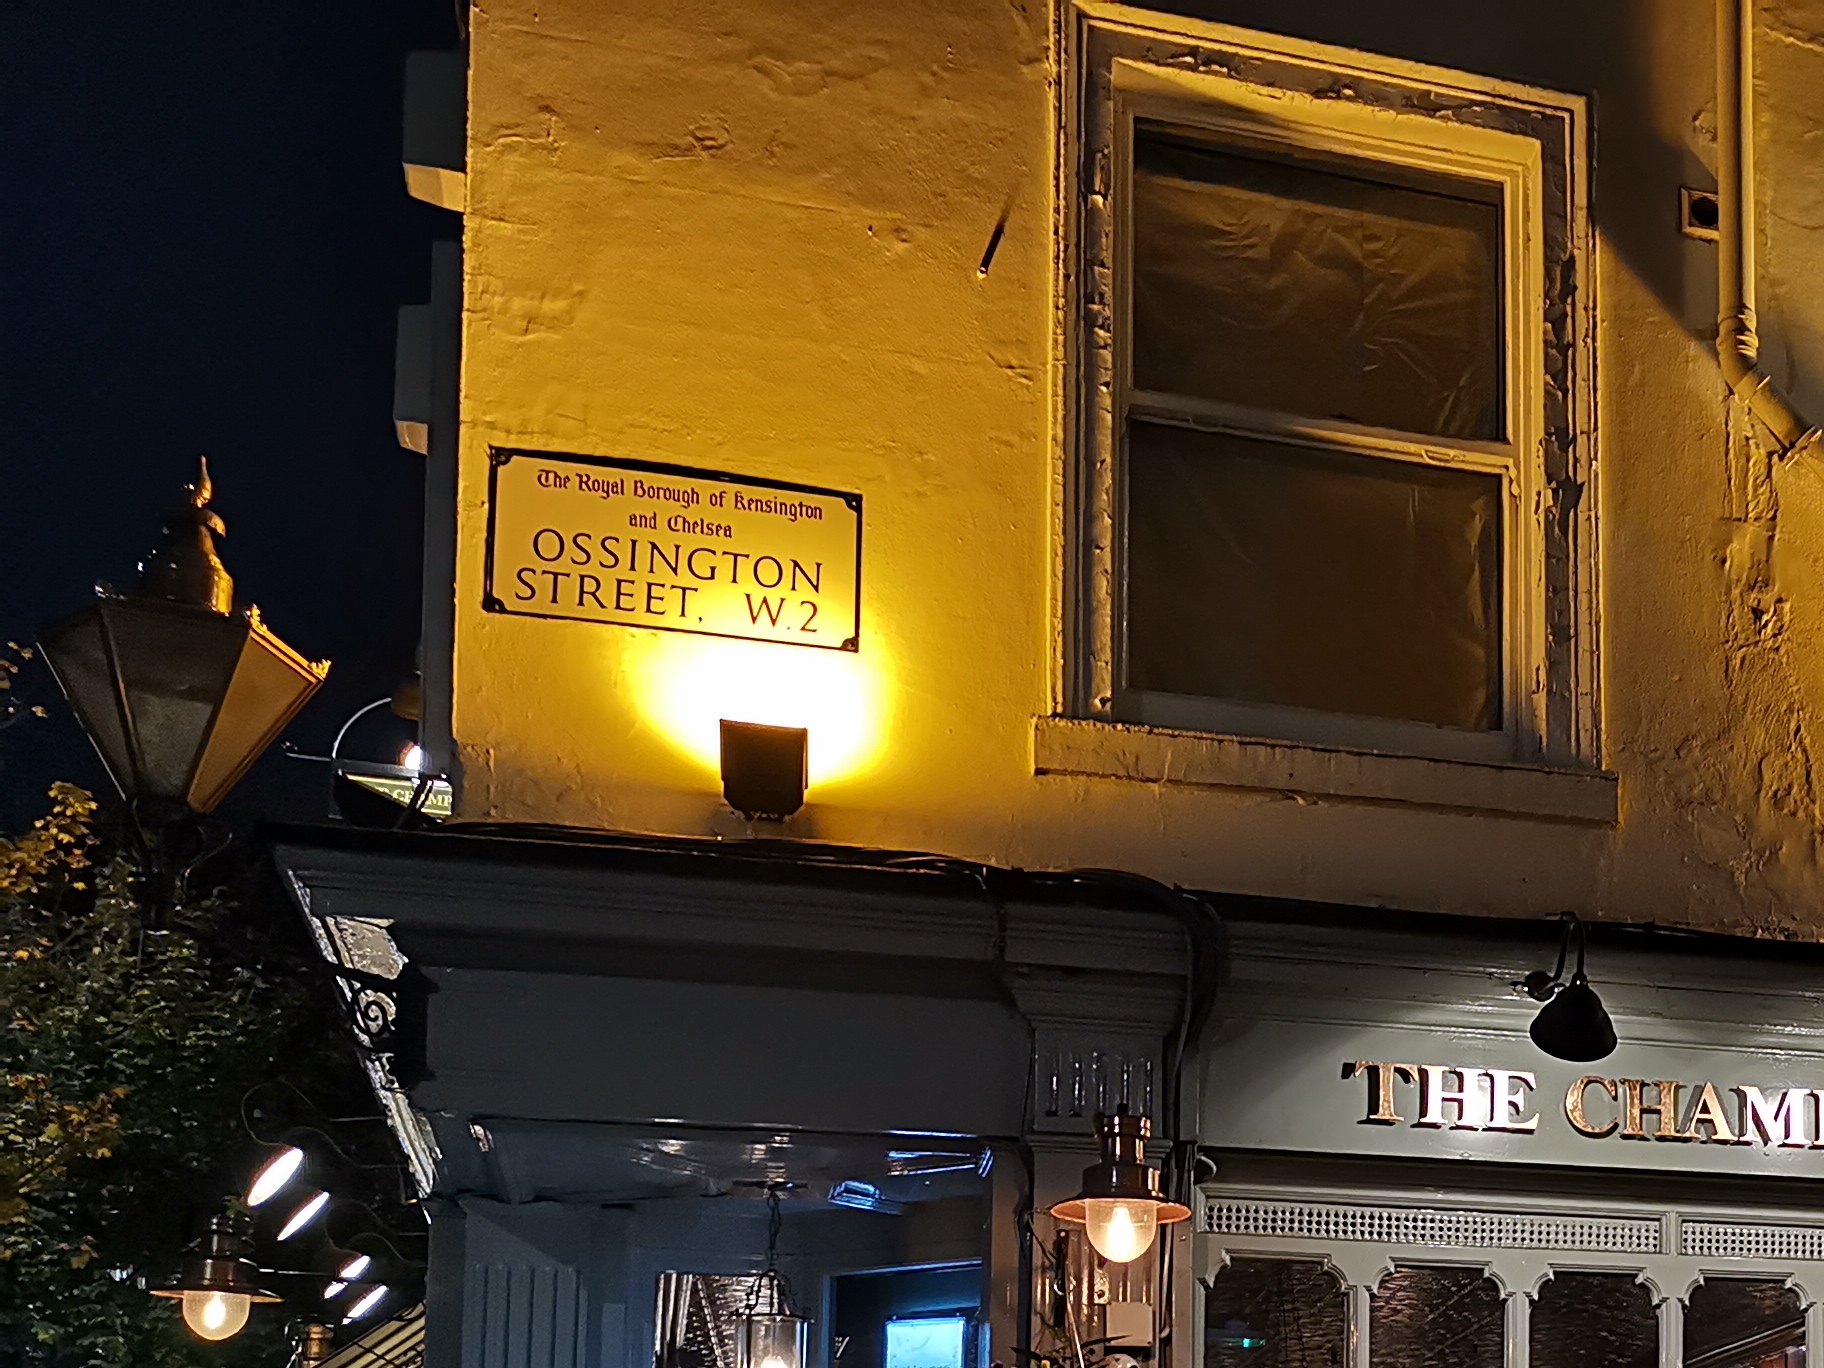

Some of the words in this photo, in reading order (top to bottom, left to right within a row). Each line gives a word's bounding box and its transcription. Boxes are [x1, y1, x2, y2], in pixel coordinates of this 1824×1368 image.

[537, 469, 571, 489] The
[575, 472, 625, 500] Royal
[633, 479, 700, 509] Borough
[709, 490, 727, 508] of
[734, 491, 823, 523] Kensington
[629, 511, 657, 530] and
[667, 514, 733, 539] Chelsea
[532, 528, 823, 594] OSSINGTON
[1350, 1060, 1541, 1133] THE
